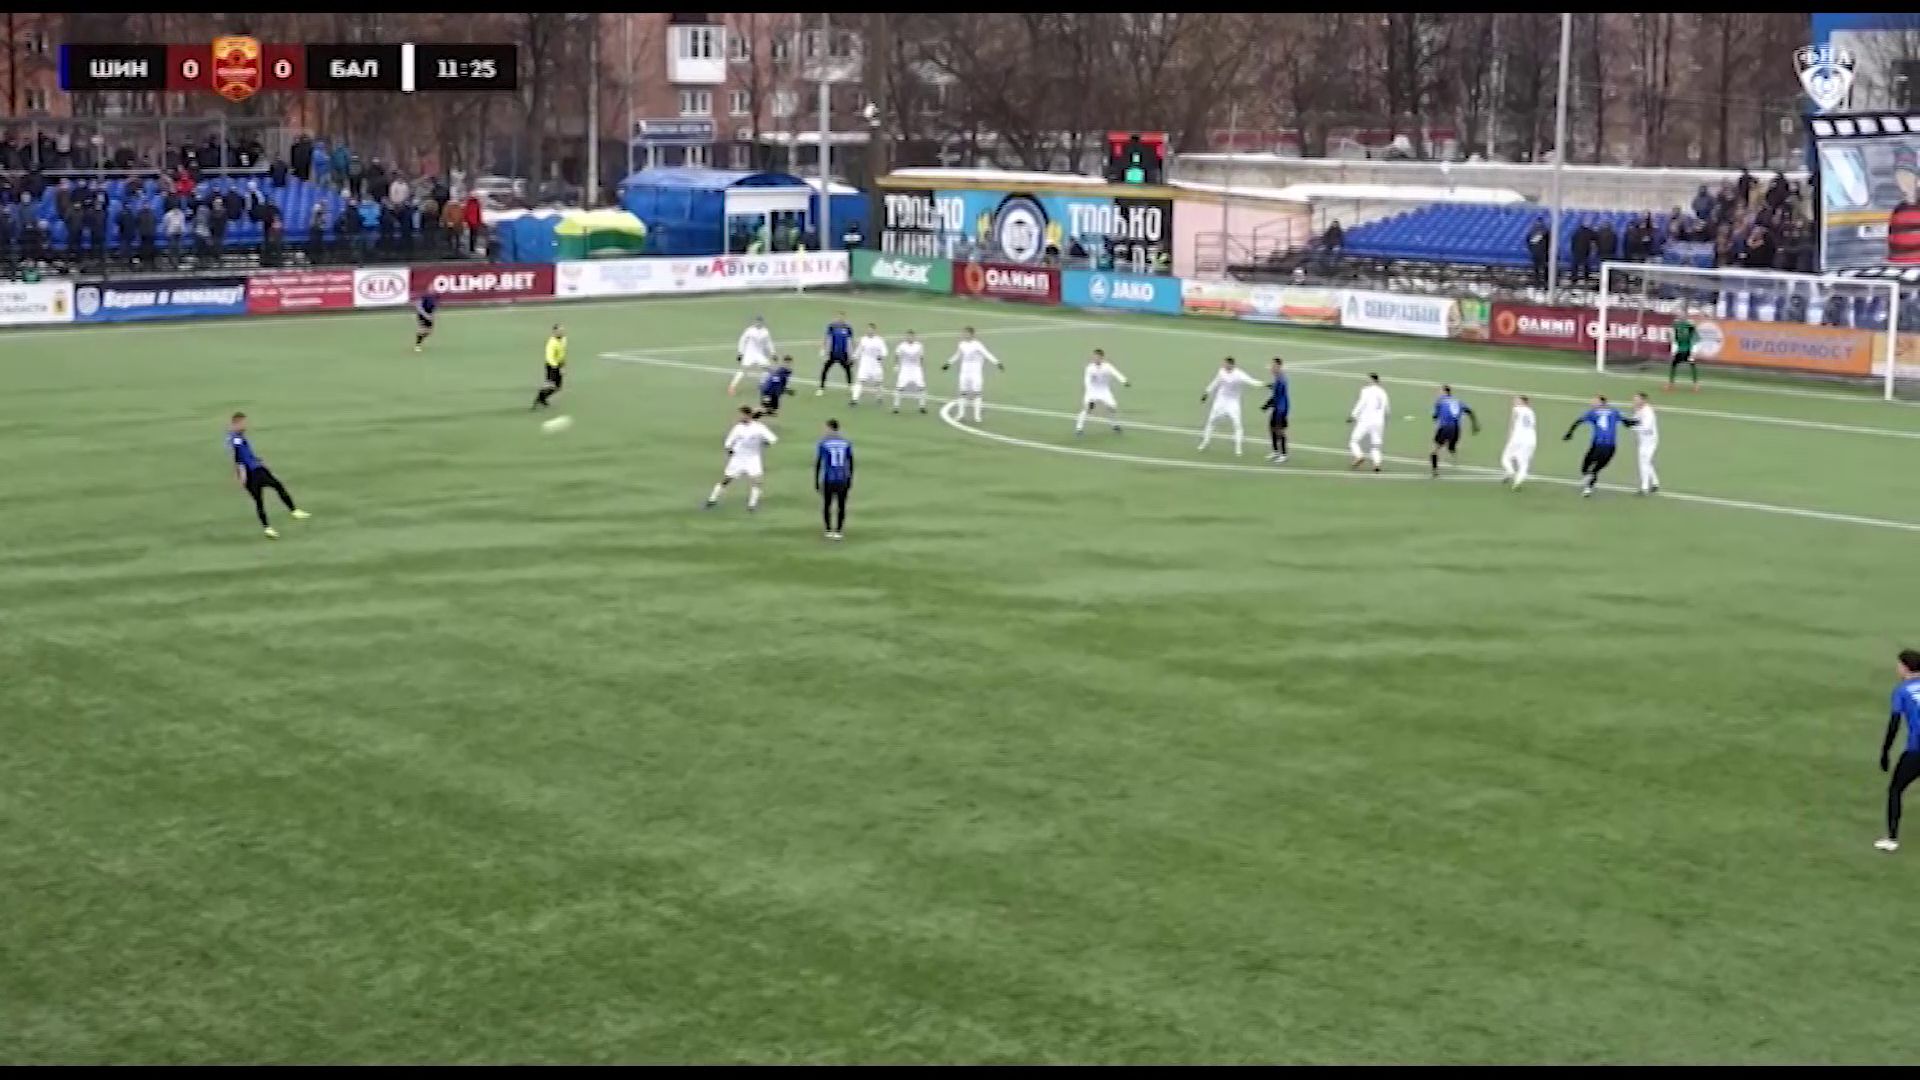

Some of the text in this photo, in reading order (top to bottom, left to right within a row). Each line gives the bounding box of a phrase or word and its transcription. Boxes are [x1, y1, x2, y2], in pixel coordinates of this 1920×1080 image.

[433, 271, 536, 294] OLIMP.BET
[985, 269, 1050, 291] ОЛИМП
[1111, 279, 1155, 301] JAKO
[1516, 315, 1576, 333] ОЛИМП
